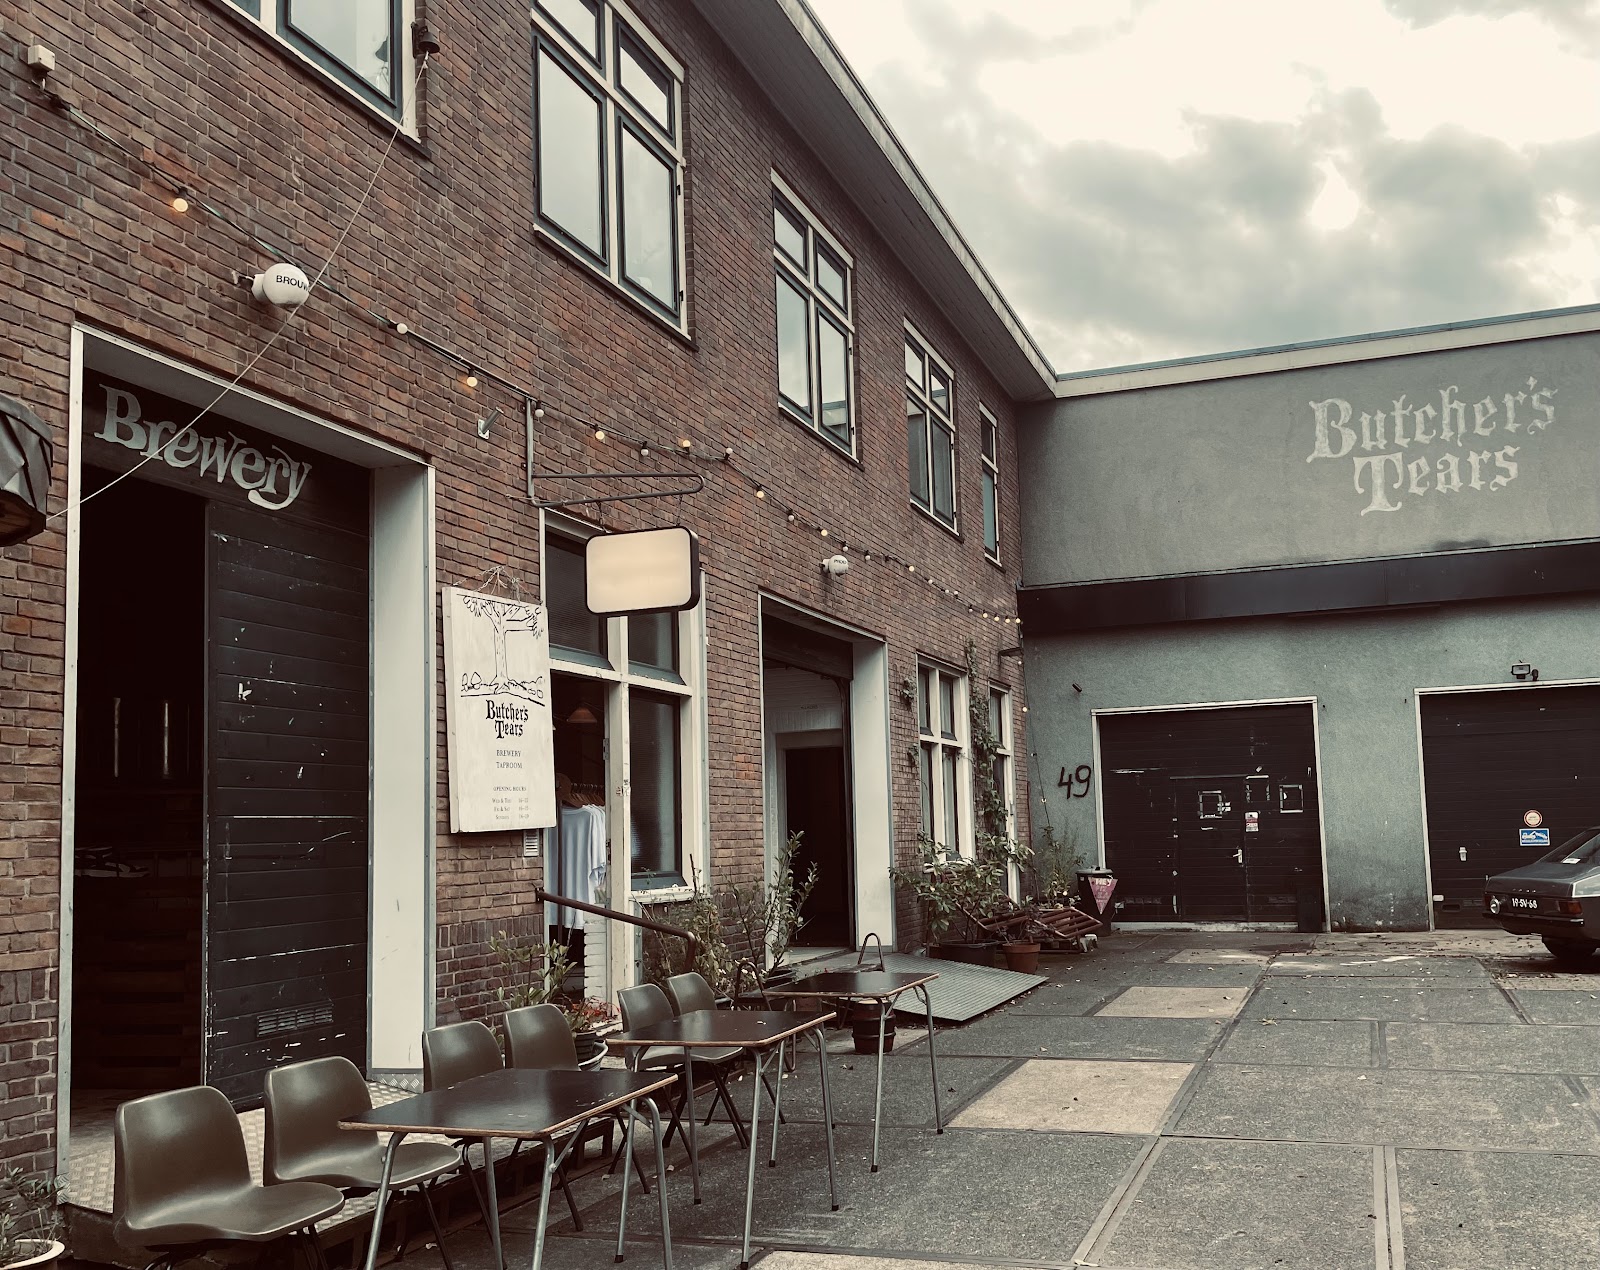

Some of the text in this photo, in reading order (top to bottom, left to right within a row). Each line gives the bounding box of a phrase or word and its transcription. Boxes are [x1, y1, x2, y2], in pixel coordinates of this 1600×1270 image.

[1306, 376, 1558, 463] Butcher's
[94, 384, 312, 510] Brewery
[1353, 445, 1520, 516] Tears
[485, 699, 529, 722] Butcher's
[494, 719, 524, 739] Tears
[496, 749, 521, 758] BREWERY
[496, 761, 523, 769] TAPROOM
[1058, 764, 1092, 800] 49
